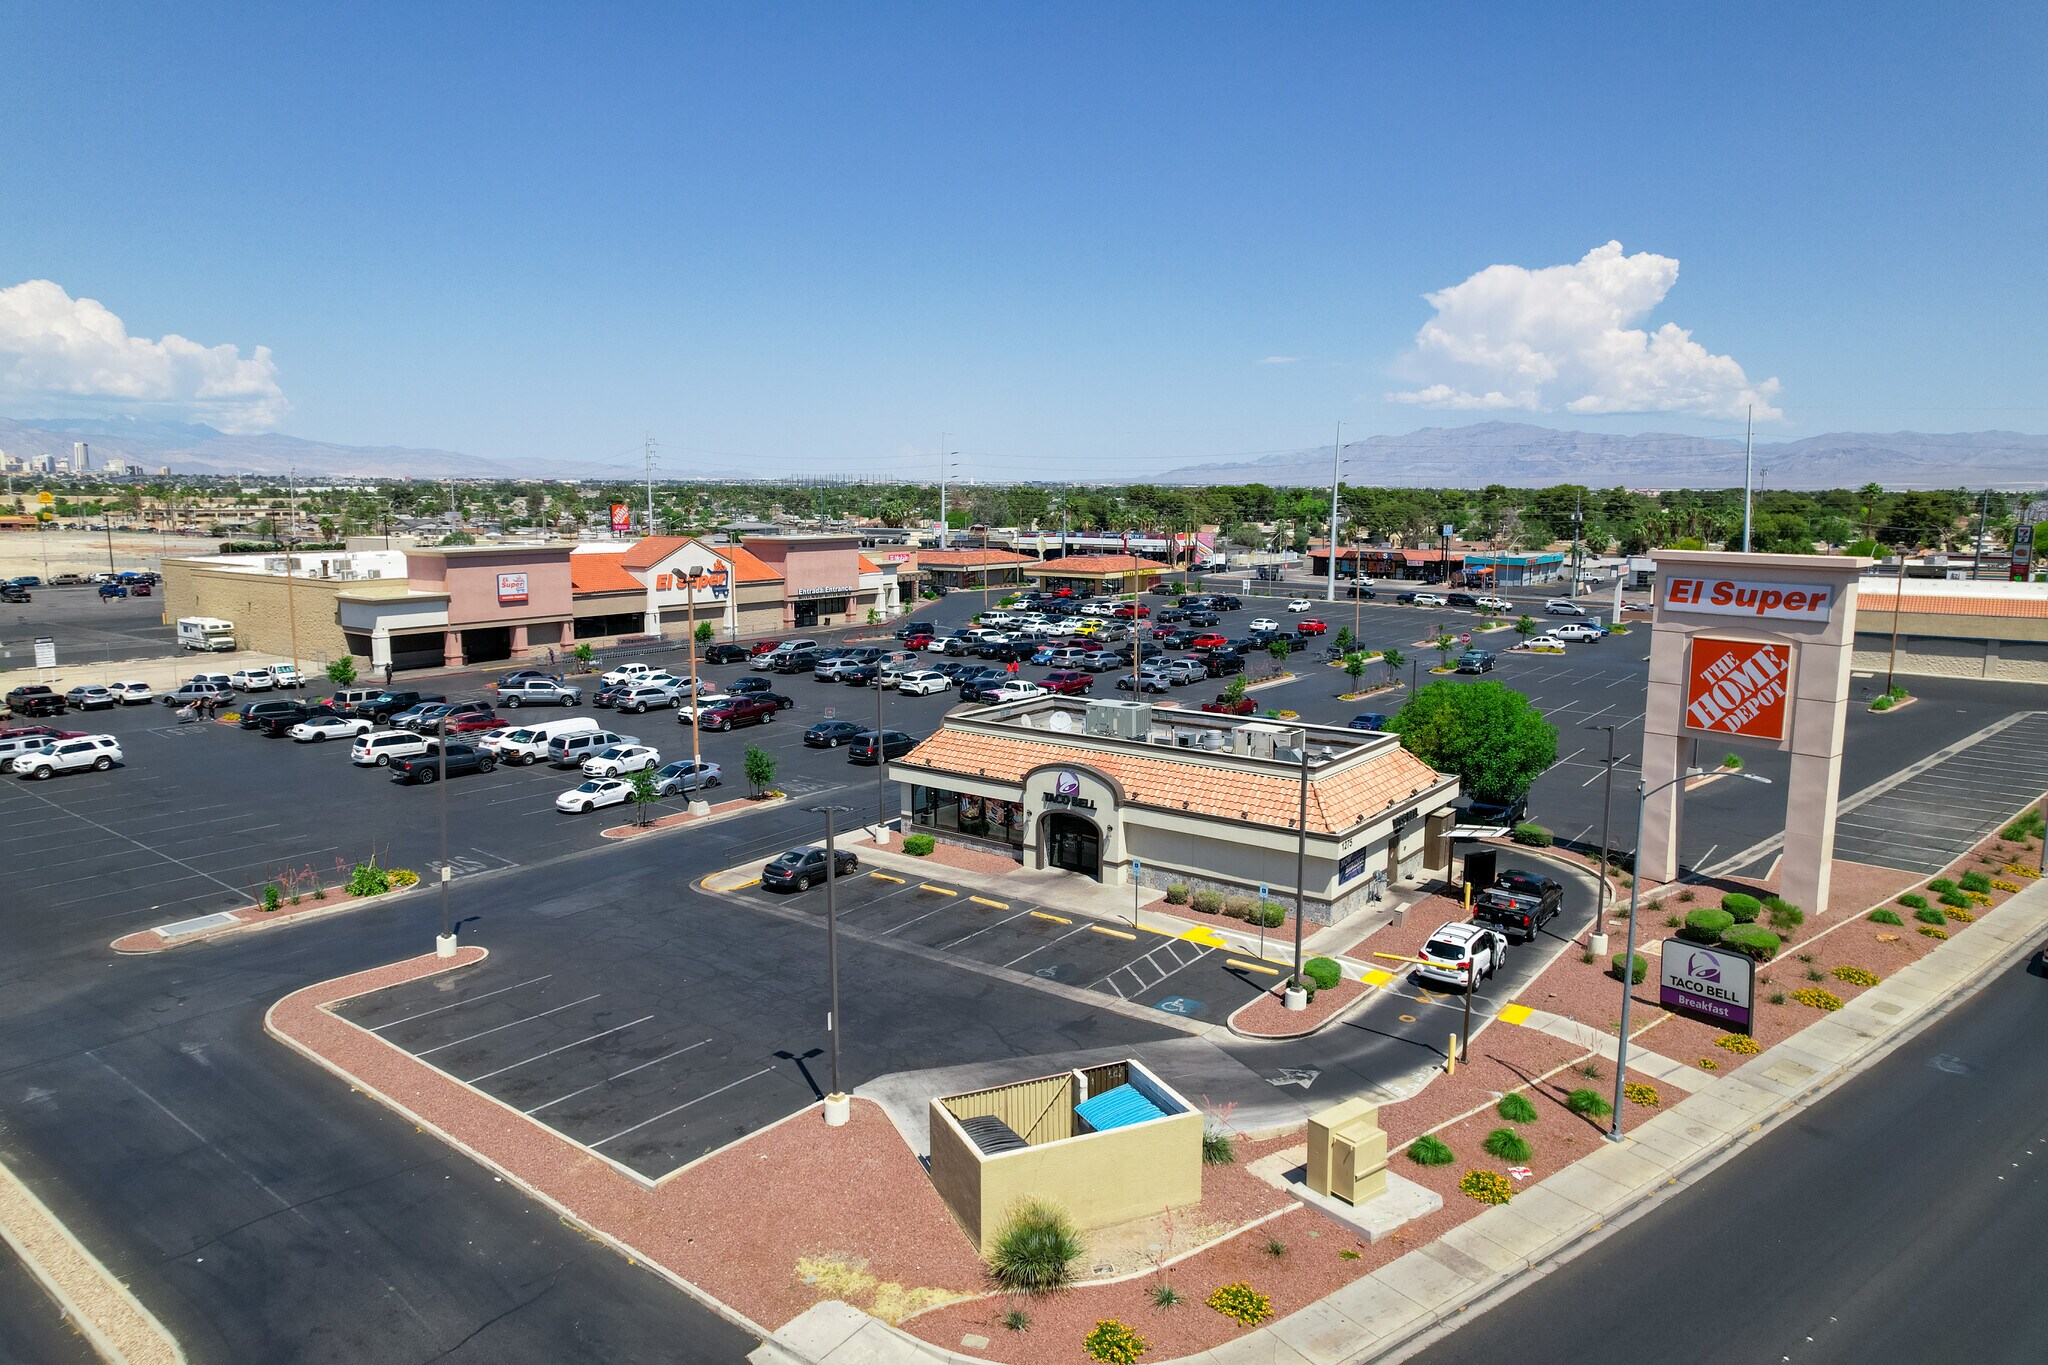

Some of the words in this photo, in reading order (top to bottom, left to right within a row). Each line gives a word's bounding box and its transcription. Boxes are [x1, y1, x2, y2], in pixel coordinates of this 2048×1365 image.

[656, 574, 673, 592] El
[798, 587, 823, 595] Entrada
[825, 585, 853, 594] Entrance
[1668, 579, 1704, 604] El
[1710, 581, 1828, 615] Super
[1699, 651, 1740, 686] THE
[1687, 644, 1788, 729] HOME
[1722, 678, 1786, 734] DEPOT
[166, 726, 209, 736] STOP
[1043, 792, 1070, 805] TACO
[1072, 796, 1097, 811] BELL
[1341, 838, 1353, 851] 1275
[1669, 974, 1704, 993] TACO
[1706, 985, 1740, 1003] BELL
[1678, 994, 1730, 1017] Breakfast
